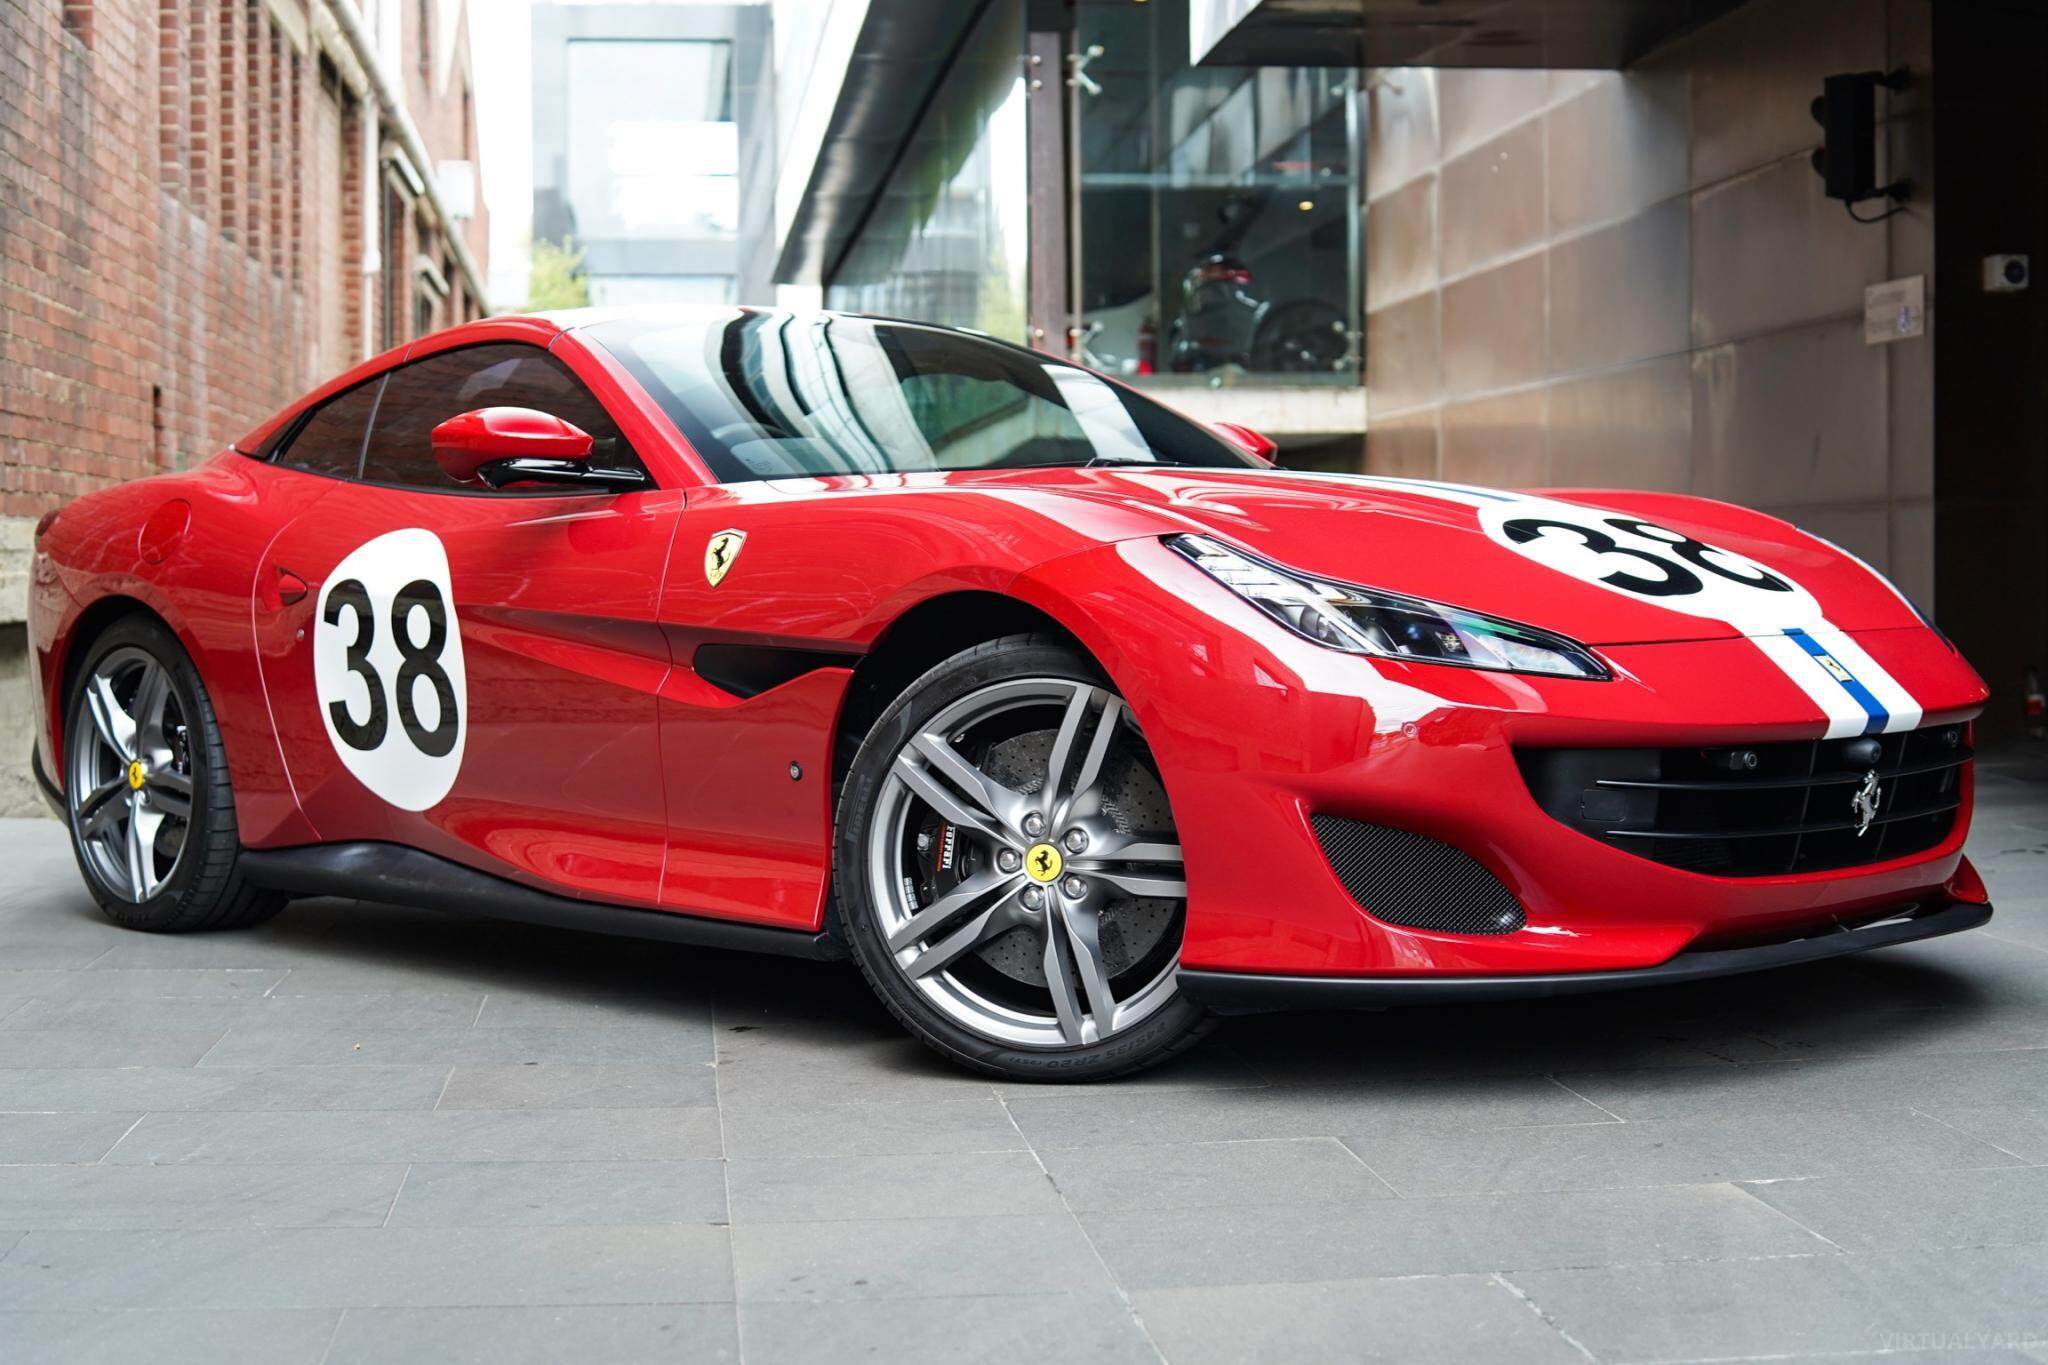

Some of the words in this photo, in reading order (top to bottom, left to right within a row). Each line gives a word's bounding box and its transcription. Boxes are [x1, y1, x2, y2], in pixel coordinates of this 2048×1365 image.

[1502, 518, 1795, 597] 38
[323, 578, 459, 758] 38
[942, 825, 956, 869] Ferrari
[1046, 1054, 1101, 1069] ZR20
